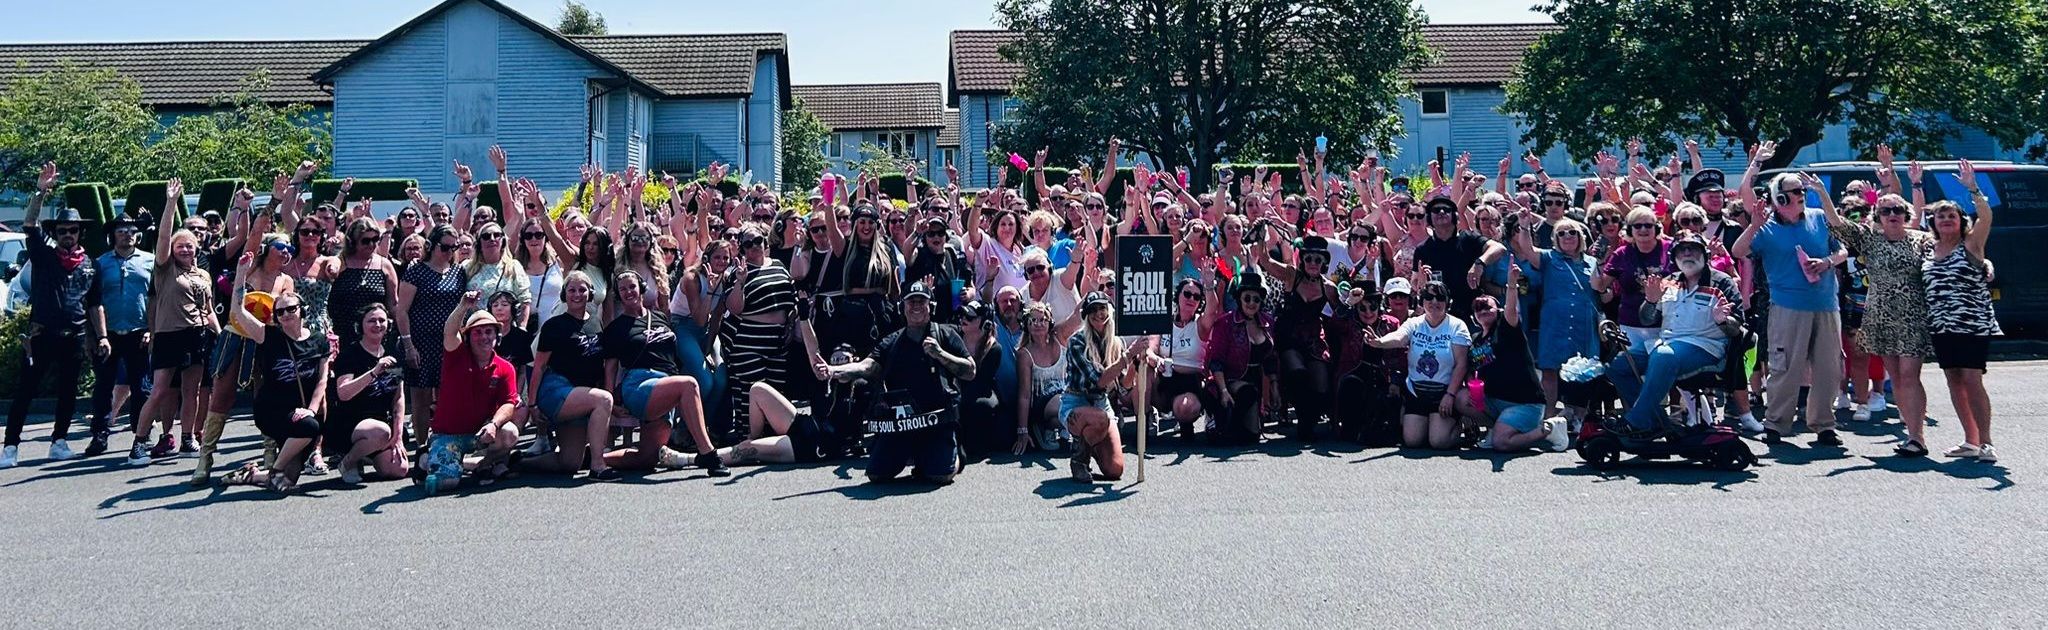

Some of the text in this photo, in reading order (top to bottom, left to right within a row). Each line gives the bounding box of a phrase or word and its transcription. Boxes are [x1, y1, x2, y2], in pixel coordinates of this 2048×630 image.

[2011, 191, 2038, 199] HOTELS
[1123, 272, 1167, 295] SOUL
[1123, 294, 1167, 312] STROLL
[869, 416, 928, 433] THE SOUL STROLL
